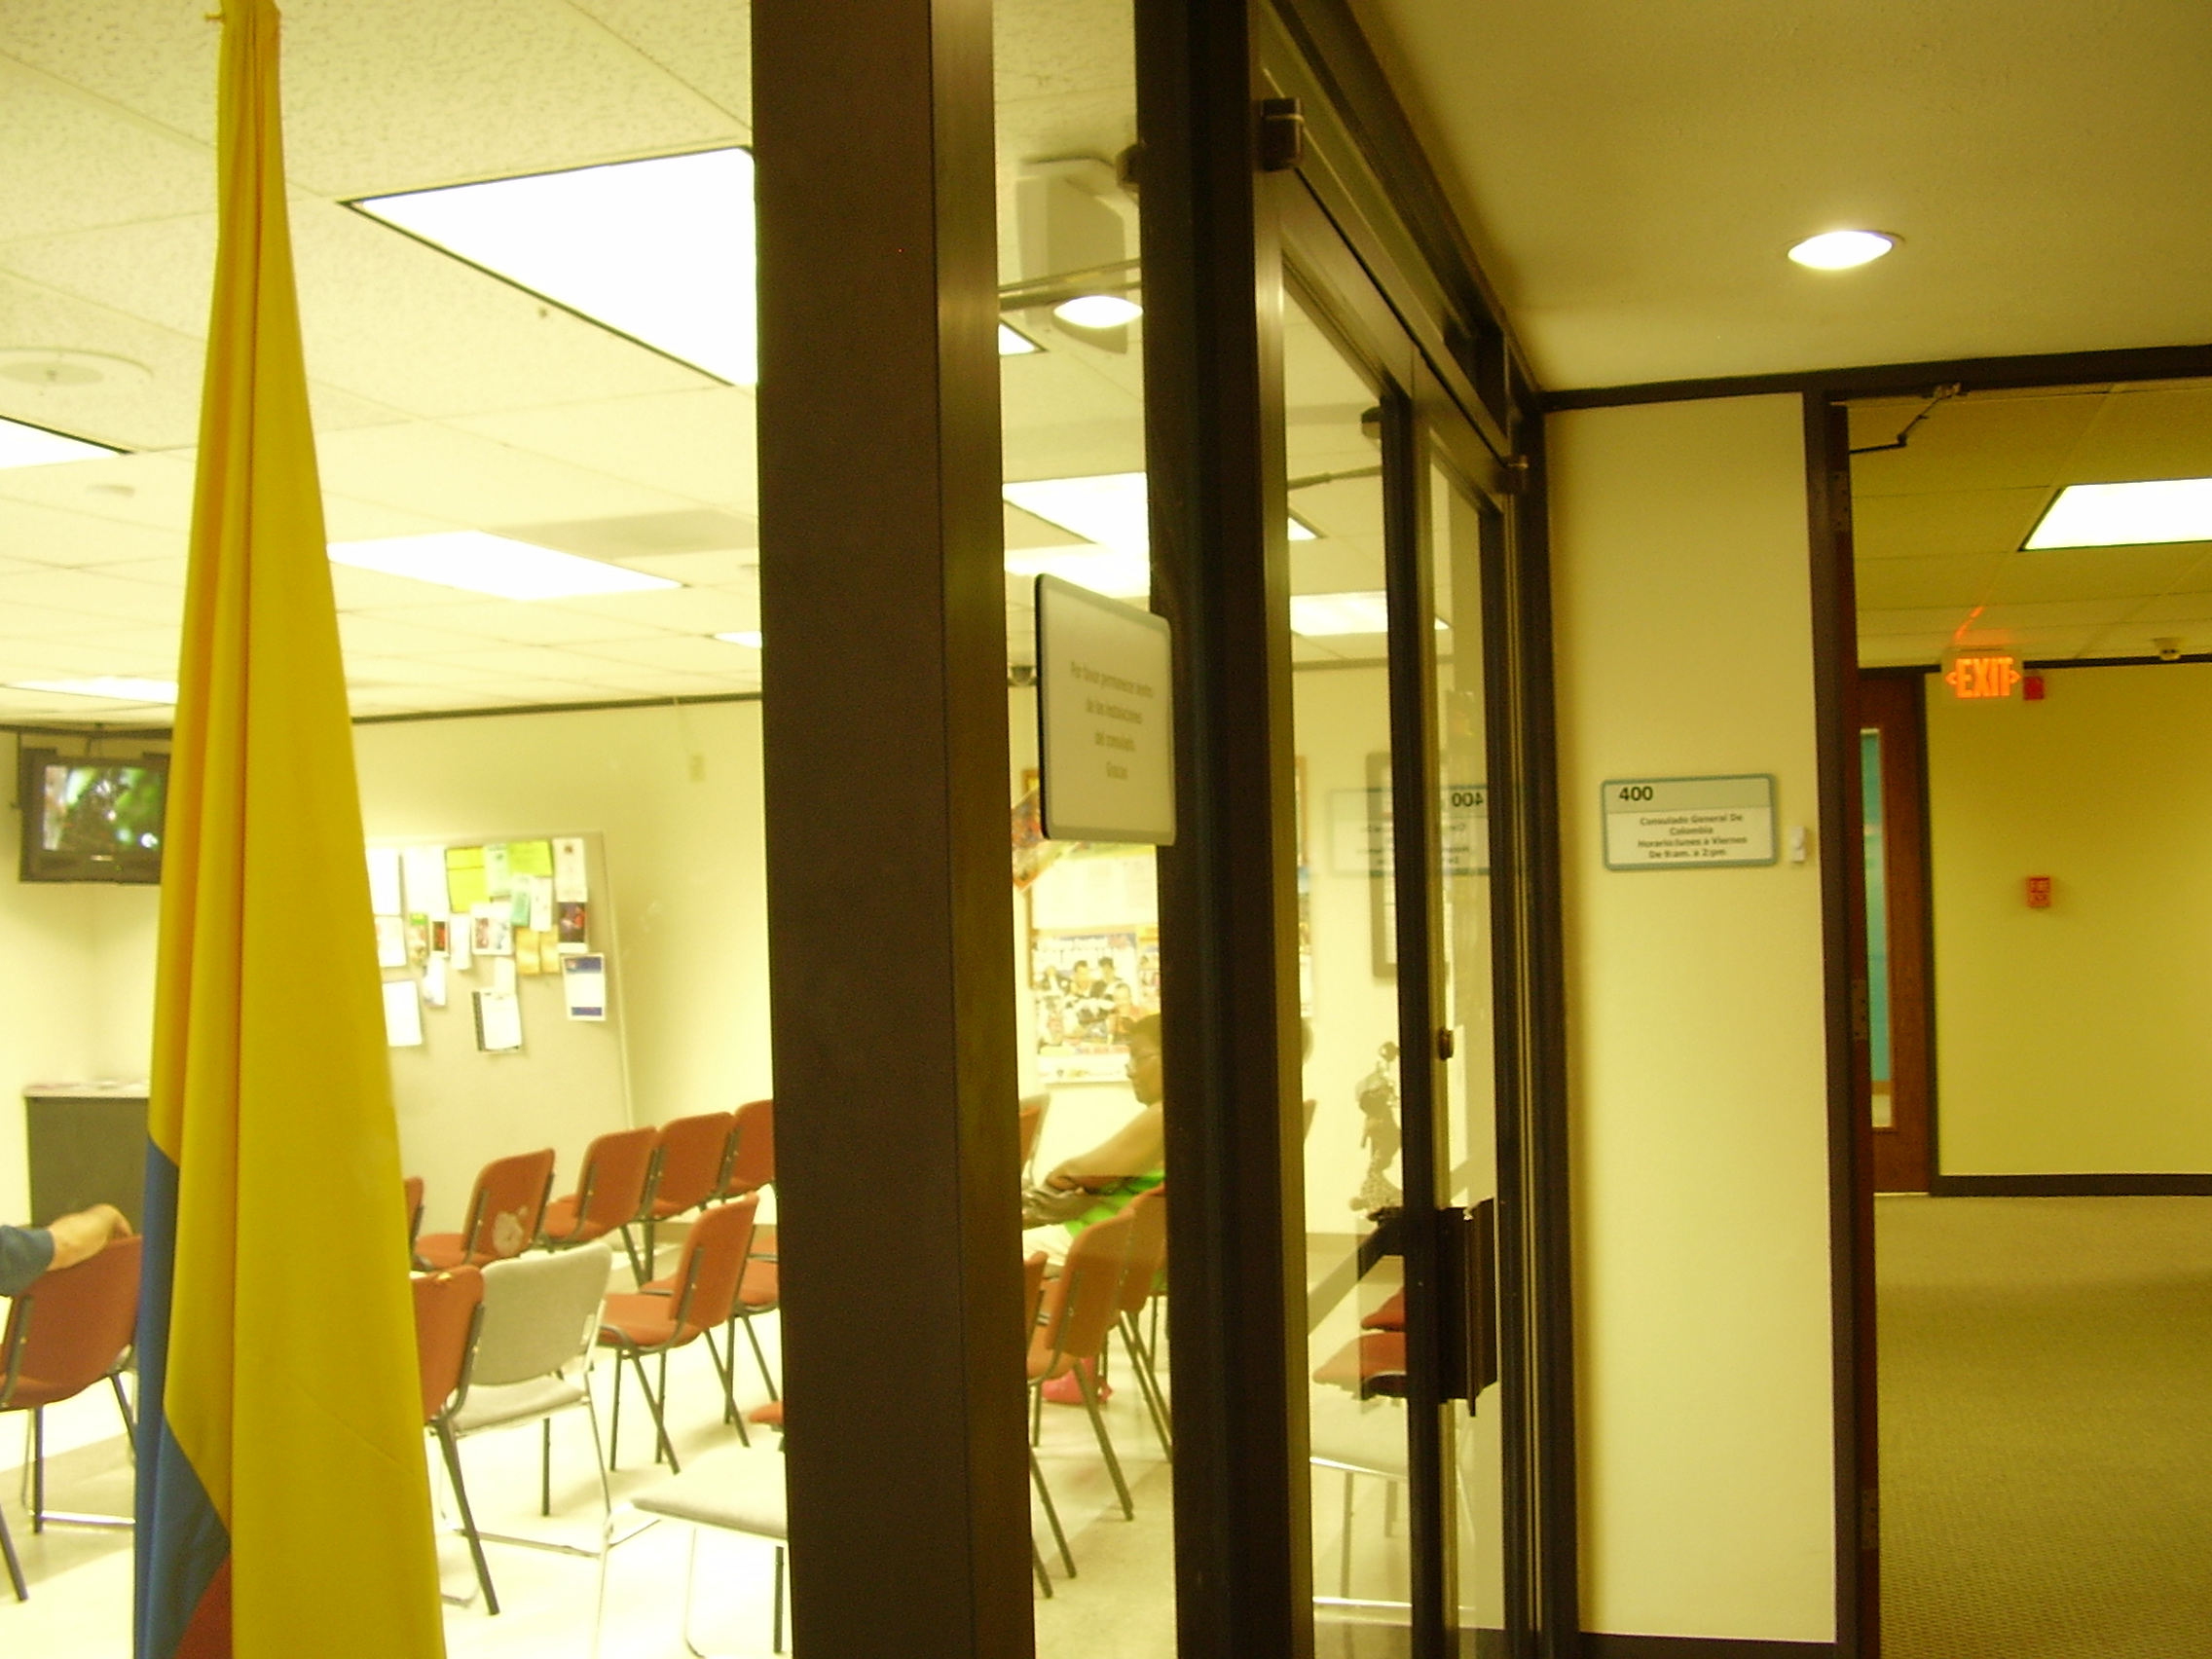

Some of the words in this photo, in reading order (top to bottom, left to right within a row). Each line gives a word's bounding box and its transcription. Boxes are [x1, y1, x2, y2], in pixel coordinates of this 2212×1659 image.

[1956, 656, 2013, 698] EXIT
[1618, 786, 1653, 801] 400
[1640, 816, 1688, 826] Consulado
[1690, 815, 1727, 824] General
[1729, 813, 1743, 822] De
[1669, 826, 1714, 835] Colombia
[1711, 836, 1748, 845] Viernes
[1648, 850, 1662, 859] De
